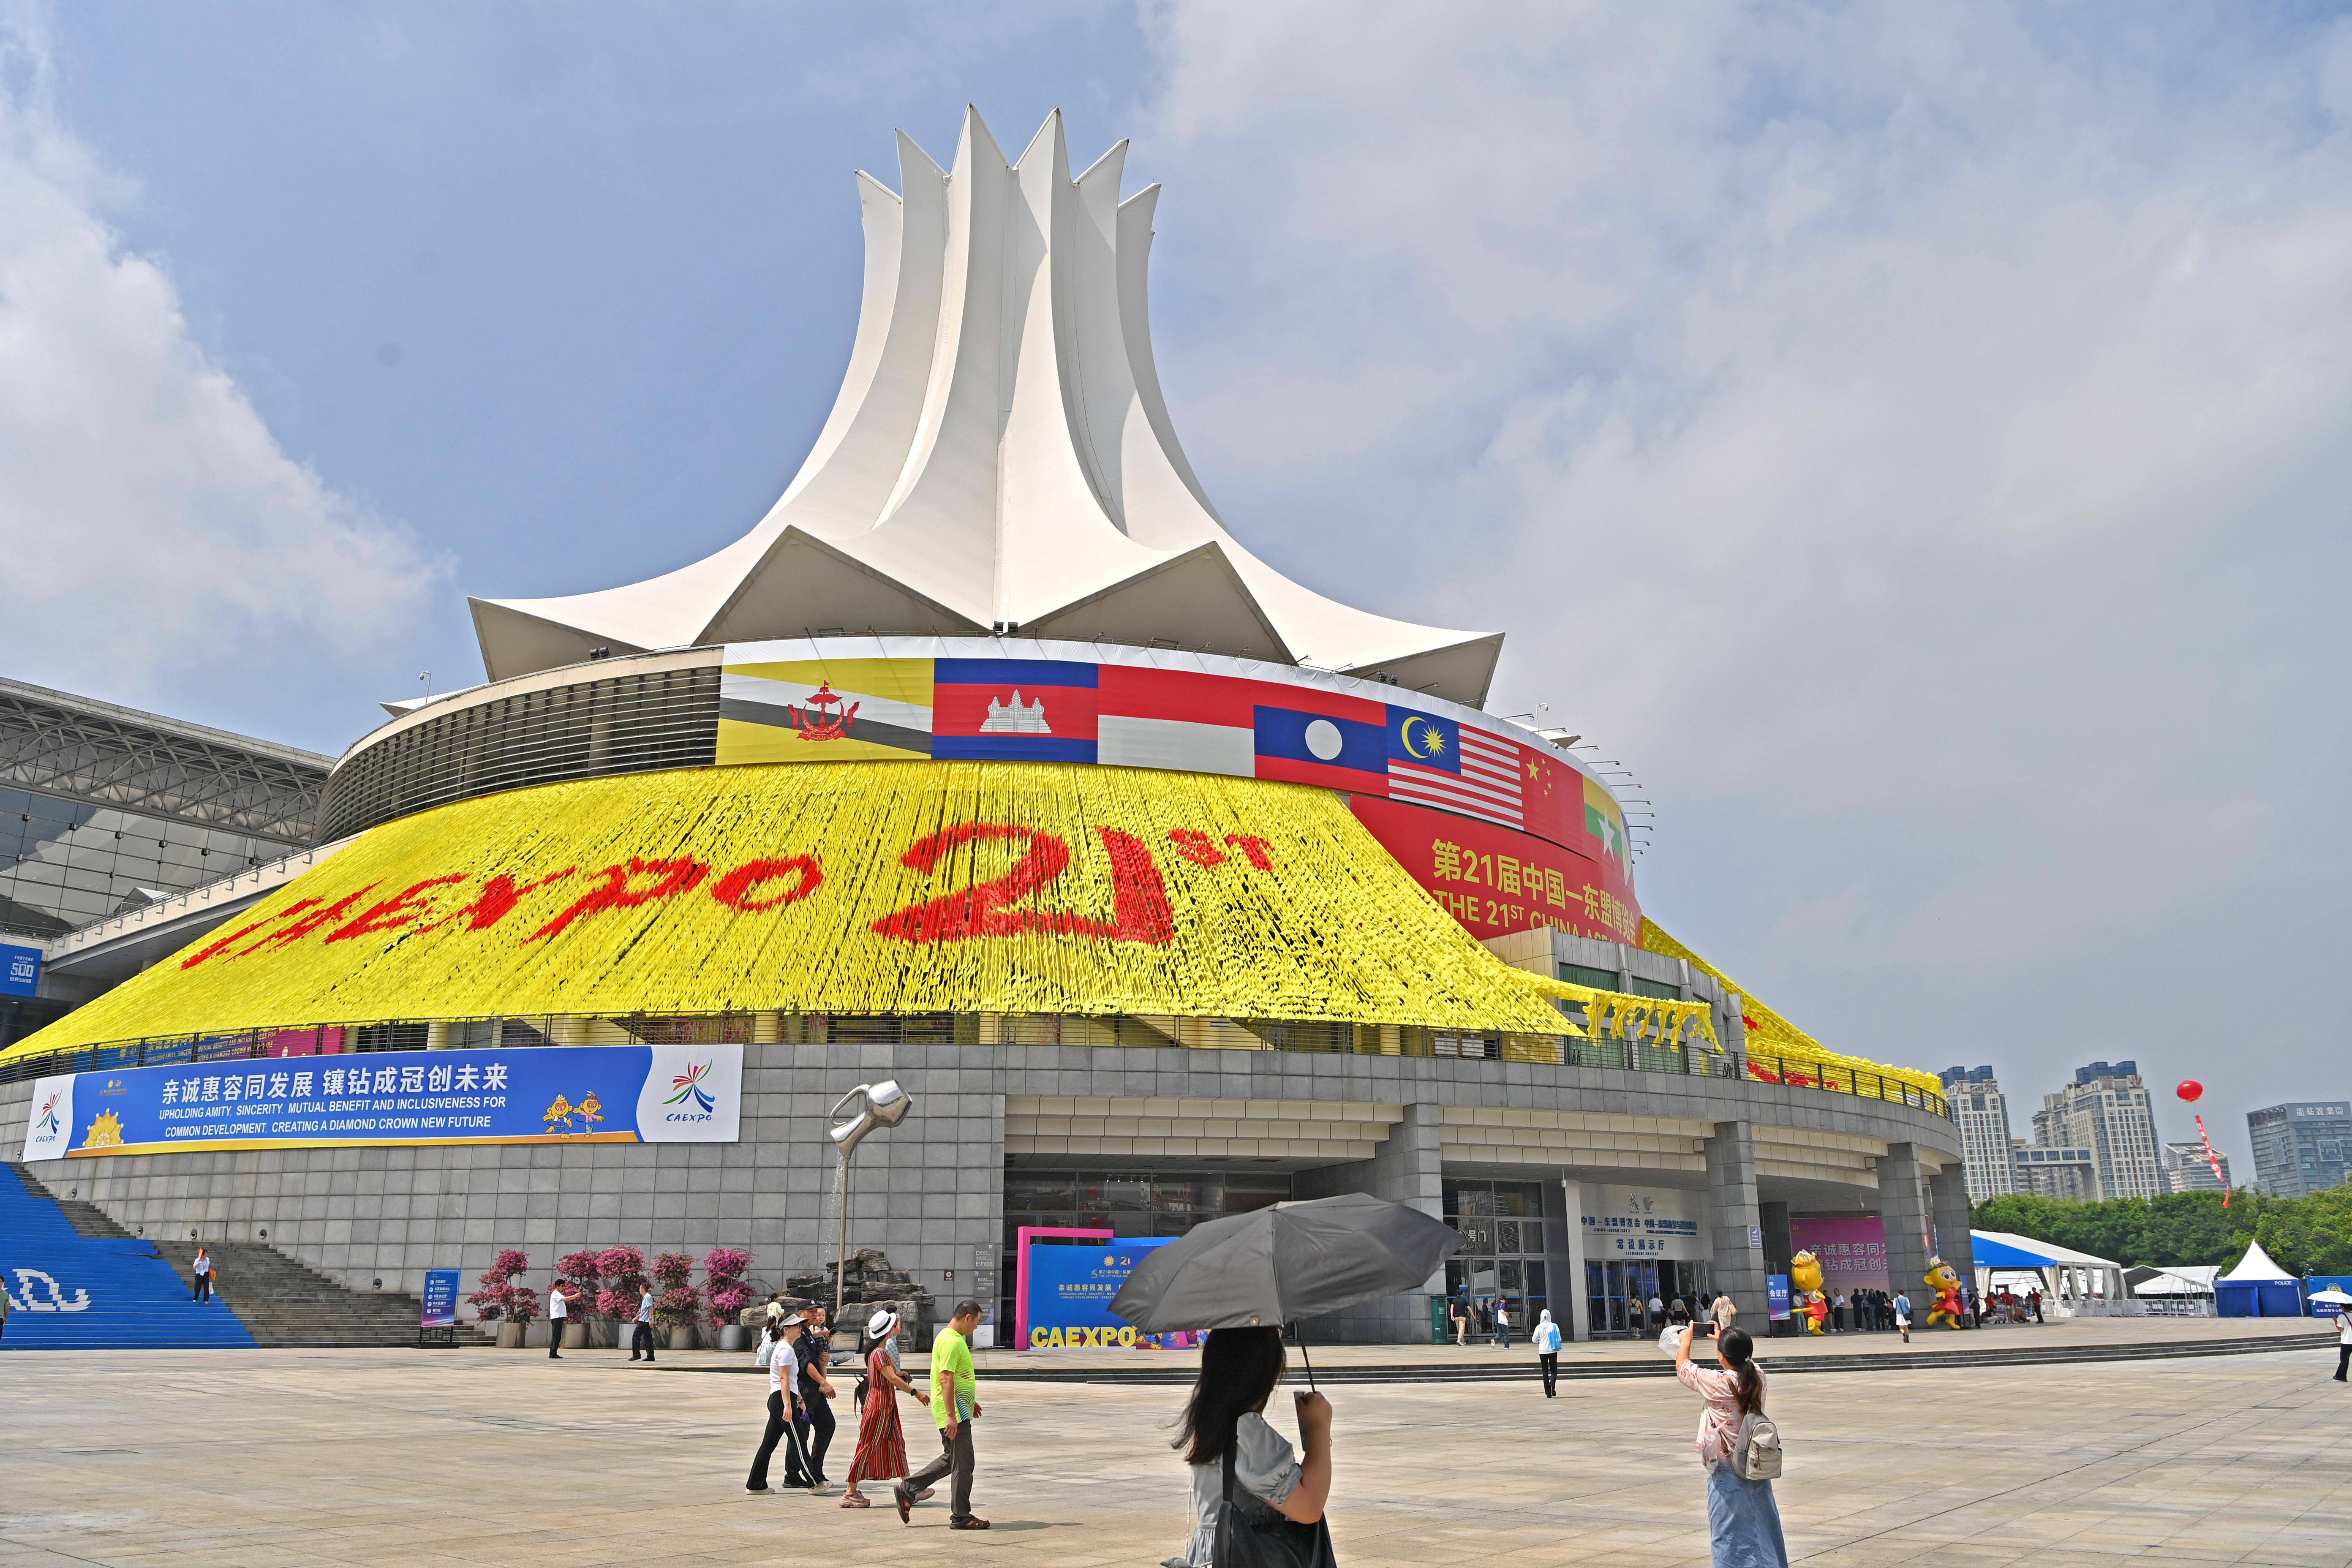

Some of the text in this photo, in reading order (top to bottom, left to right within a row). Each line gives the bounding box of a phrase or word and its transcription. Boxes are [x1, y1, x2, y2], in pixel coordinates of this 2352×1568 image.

[1432, 890, 1480, 922] THE
[10, 962, 34, 977] 500
[162, 1063, 508, 1105] 亲诚惠容同发展 镶钻成冠创未来
[159, 1106, 204, 1120] UPHOLDING
[288, 1101, 326, 1113] MUTUAL
[329, 1099, 371, 1112] BENEFIT
[372, 1099, 395, 1111] AND
[397, 1097, 480, 1110] INCLUSIVENESS
[483, 1096, 506, 1108] FOR
[666, 1113, 712, 1124] CAEXPO
[165, 1125, 201, 1138] COMMON
[272, 1120, 318, 1133] CREATING
[320, 1120, 327, 1131] A
[329, 1119, 376, 1130] DIAMOND
[378, 1118, 418, 1130] CROWN
[422, 1117, 446, 1128] NEW
[448, 1116, 491, 1127] FUTURE
[1468, 1230, 1486, 1242] 号门
[1617, 1238, 1664, 1250] 常设展示厅
[1032, 1326, 1136, 1348] CAEXPO
